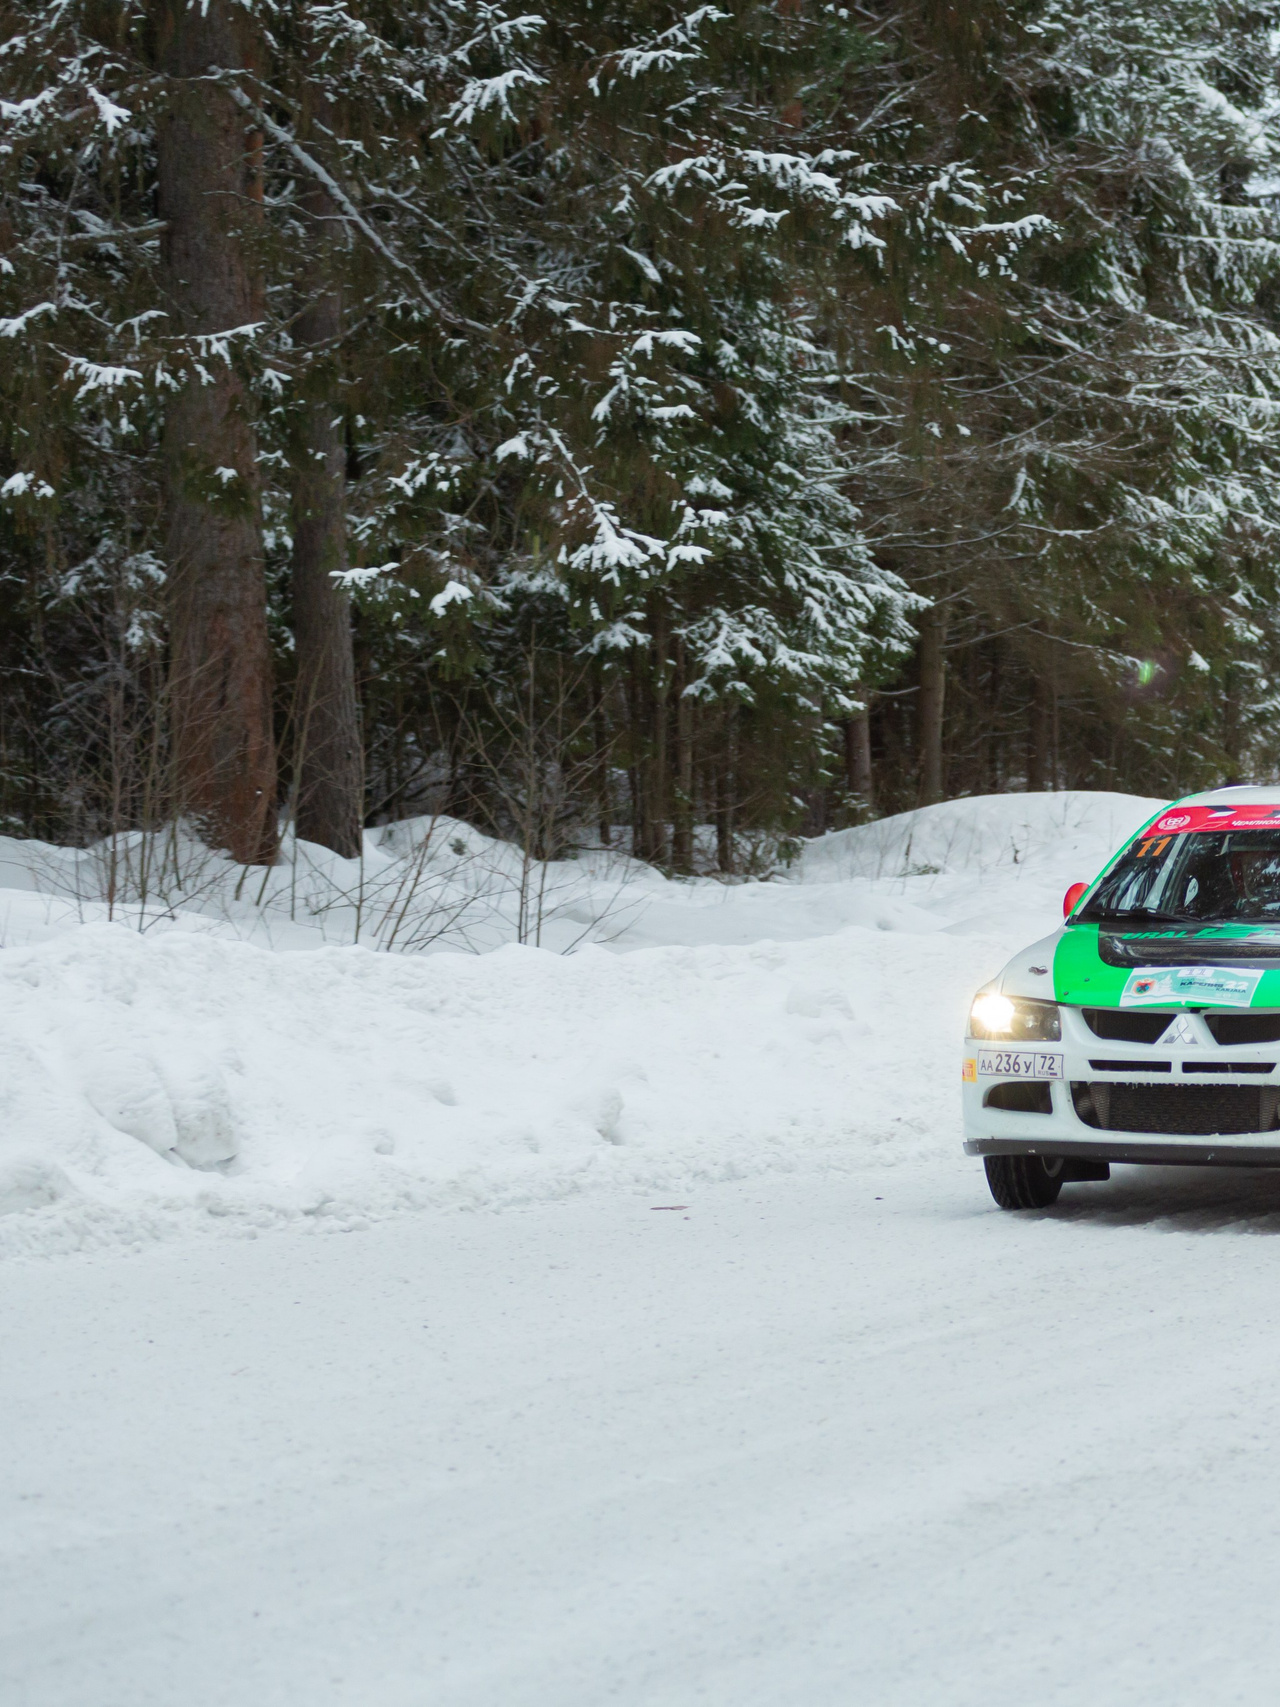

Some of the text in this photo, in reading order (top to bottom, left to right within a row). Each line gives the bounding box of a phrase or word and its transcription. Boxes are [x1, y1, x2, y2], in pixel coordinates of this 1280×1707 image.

[1136, 837, 1172, 858] 11
[1121, 930, 1189, 940] URAL
[1040, 1055, 1055, 1070] 72
